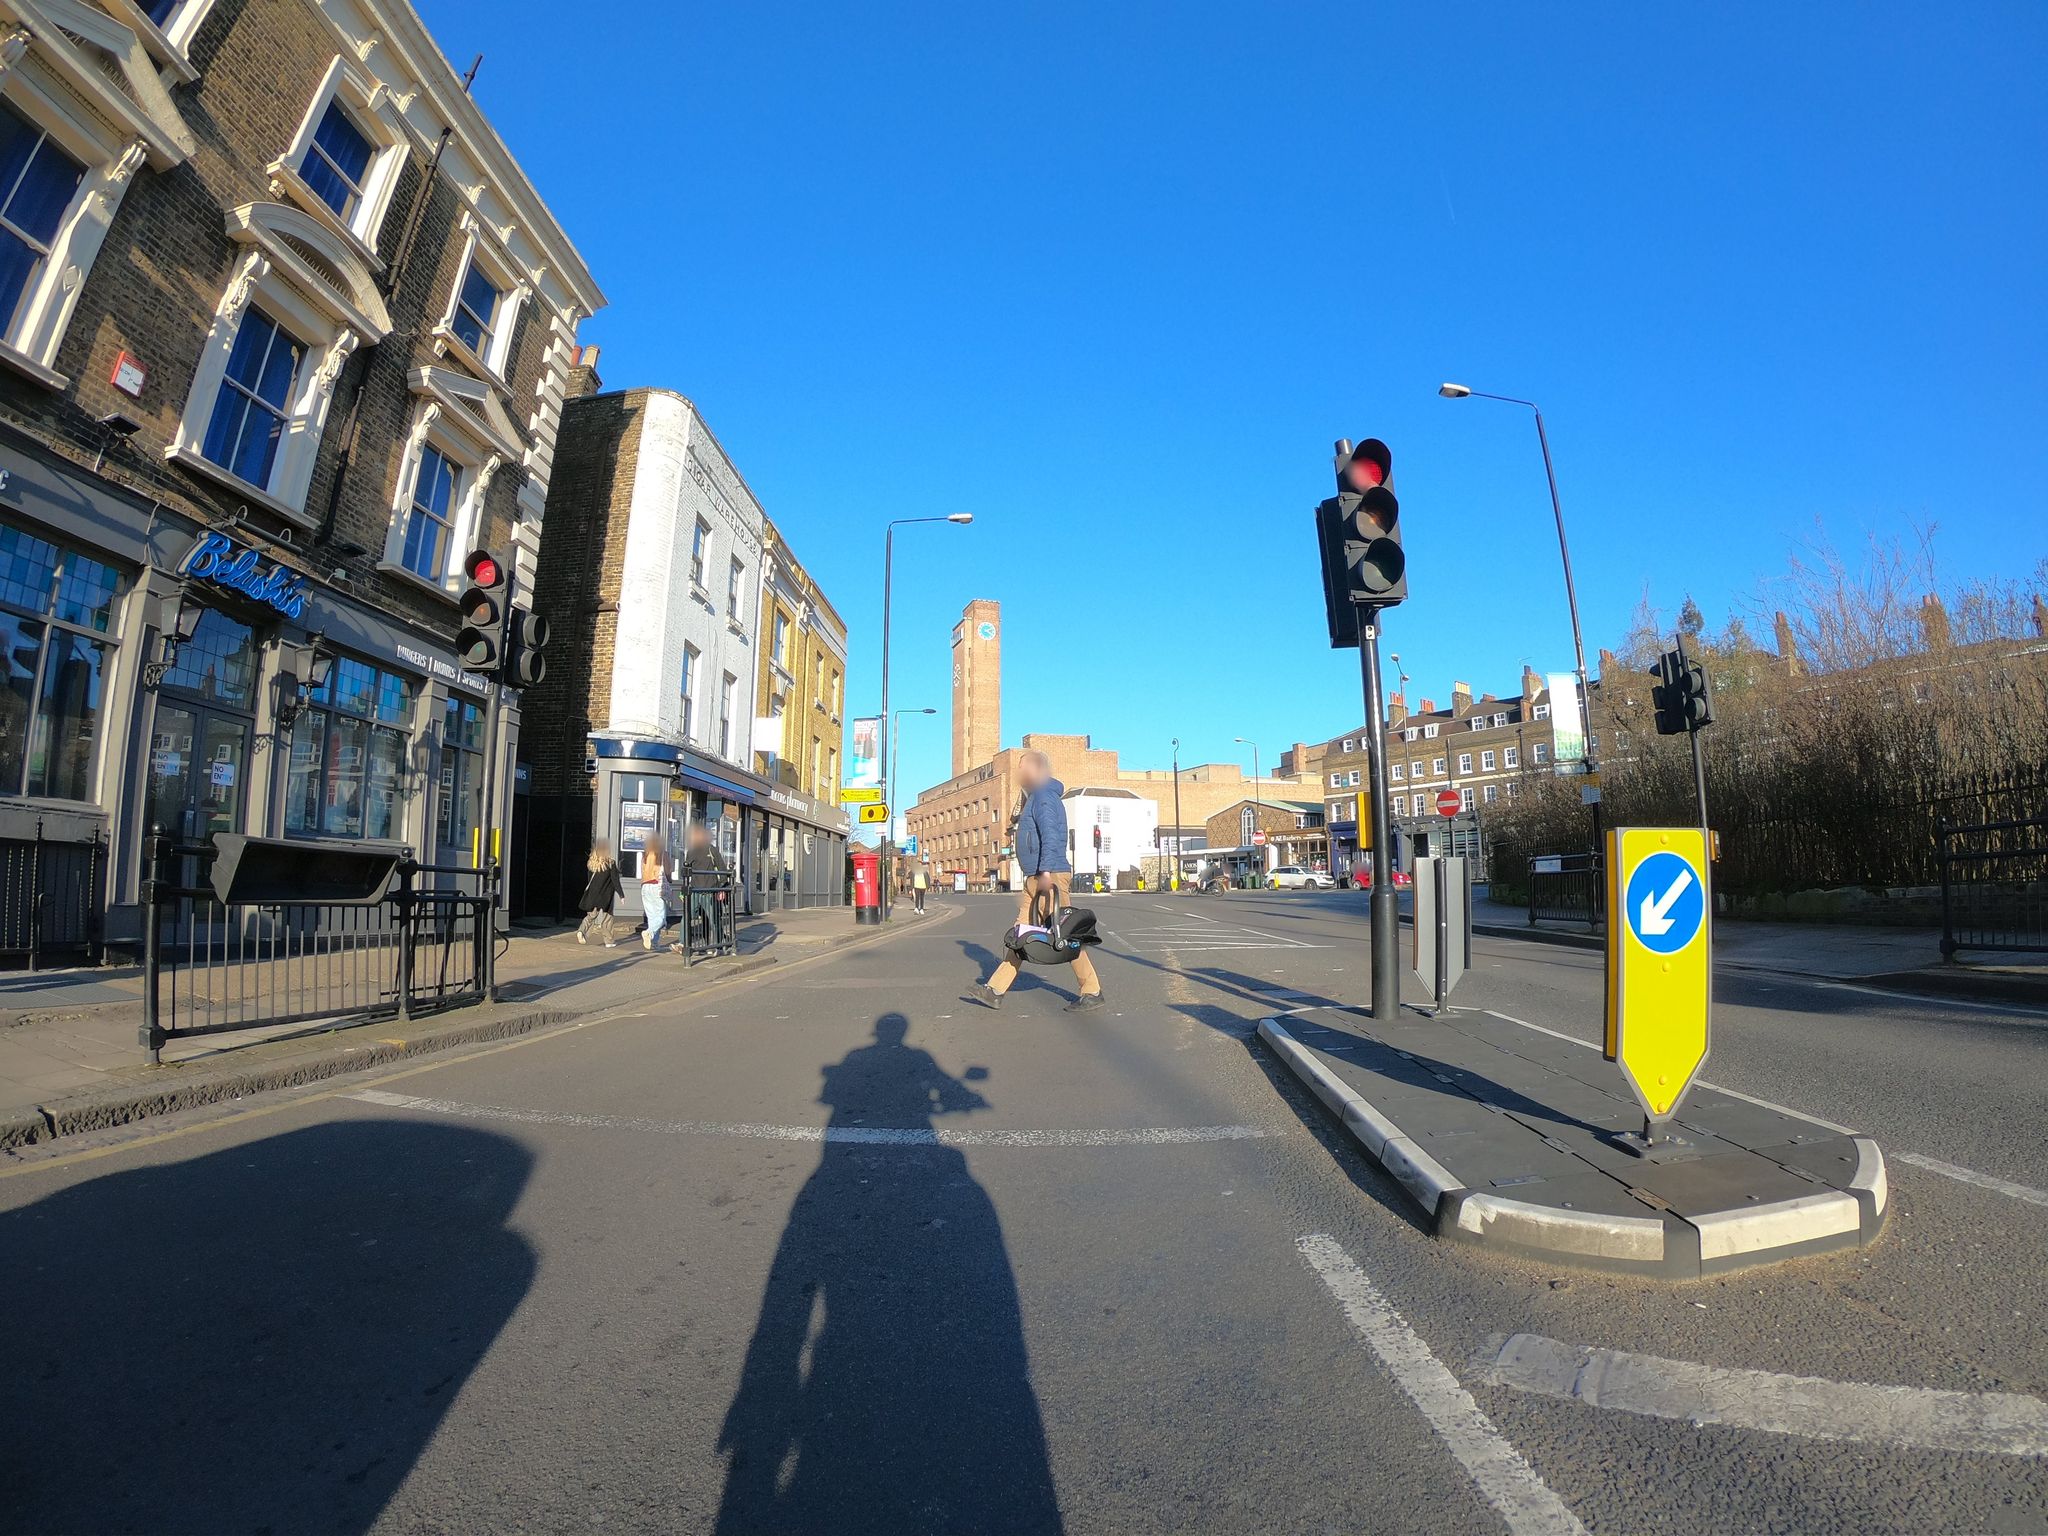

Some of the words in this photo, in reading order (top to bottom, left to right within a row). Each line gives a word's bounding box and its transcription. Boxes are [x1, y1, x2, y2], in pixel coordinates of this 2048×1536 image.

[177, 530, 306, 619] Belushi's
[397, 644, 427, 668] BURGERS
[434, 659, 456, 679] DRINKS
[214, 765, 224, 773] NO
